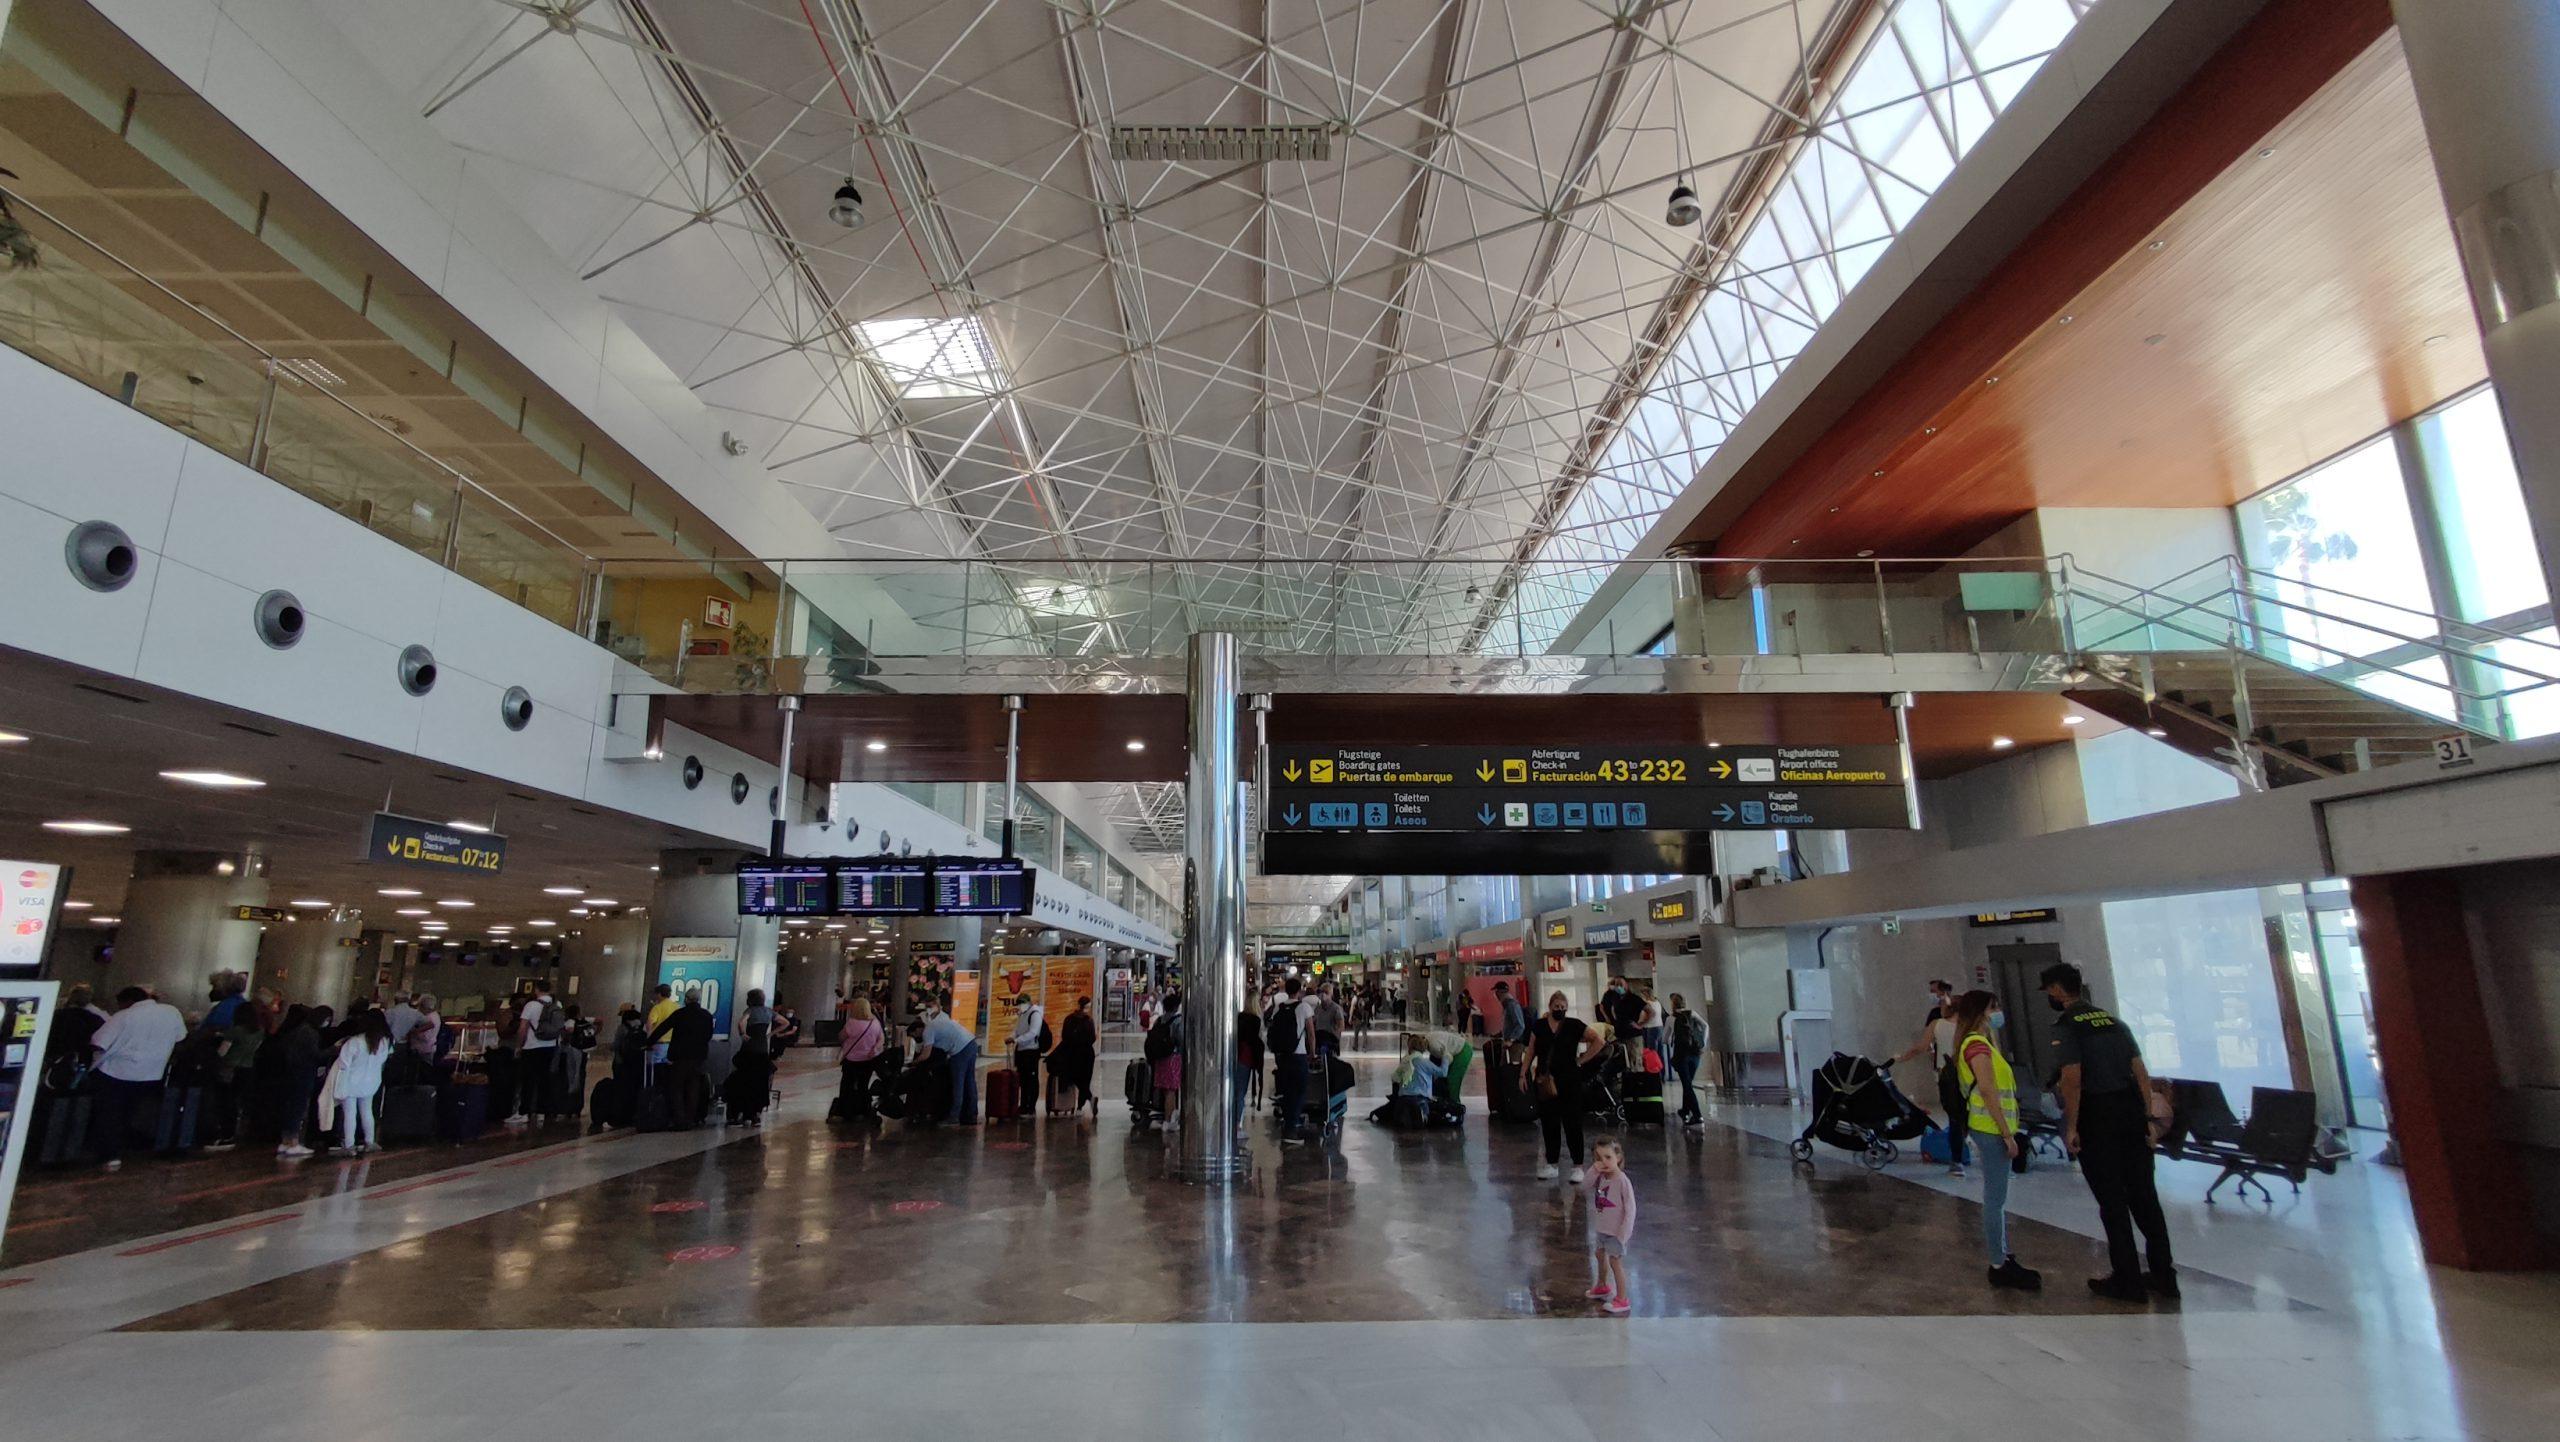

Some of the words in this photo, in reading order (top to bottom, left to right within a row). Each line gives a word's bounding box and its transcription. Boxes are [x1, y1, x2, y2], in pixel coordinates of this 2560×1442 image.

[1778, 749, 1840, 759] Flughafenbüros
[2438, 738, 2468, 760] 31
[1339, 750, 1381, 760] Flugsteige
[1532, 750, 1580, 760] Abfertigung
[1339, 761, 1375, 771] Boarding
[1377, 762, 1400, 771] gates
[1532, 761, 1567, 770] Check-in
[1780, 760, 1807, 770] Airport
[1809, 760, 1838, 769] offices
[1533, 770, 1596, 782] Facturación
[1598, 760, 1629, 782] 43
[1639, 760, 1687, 782] 232
[1781, 770, 1823, 781] Oficinas
[1826, 770, 1886, 782] Aeropuerto
[1340, 772, 1381, 782] Puertas
[1384, 771, 1396, 782] de
[1399, 772, 1453, 784] embarque
[1394, 793, 1429, 802] Toiletten
[1768, 791, 1798, 801] Kapelle
[1394, 804, 1421, 813] Toilets
[1770, 803, 1798, 812] Chapel
[1395, 816, 1427, 825] Aseos
[1771, 814, 1814, 824] Oratorio
[19, 897, 45, 906] VISA
